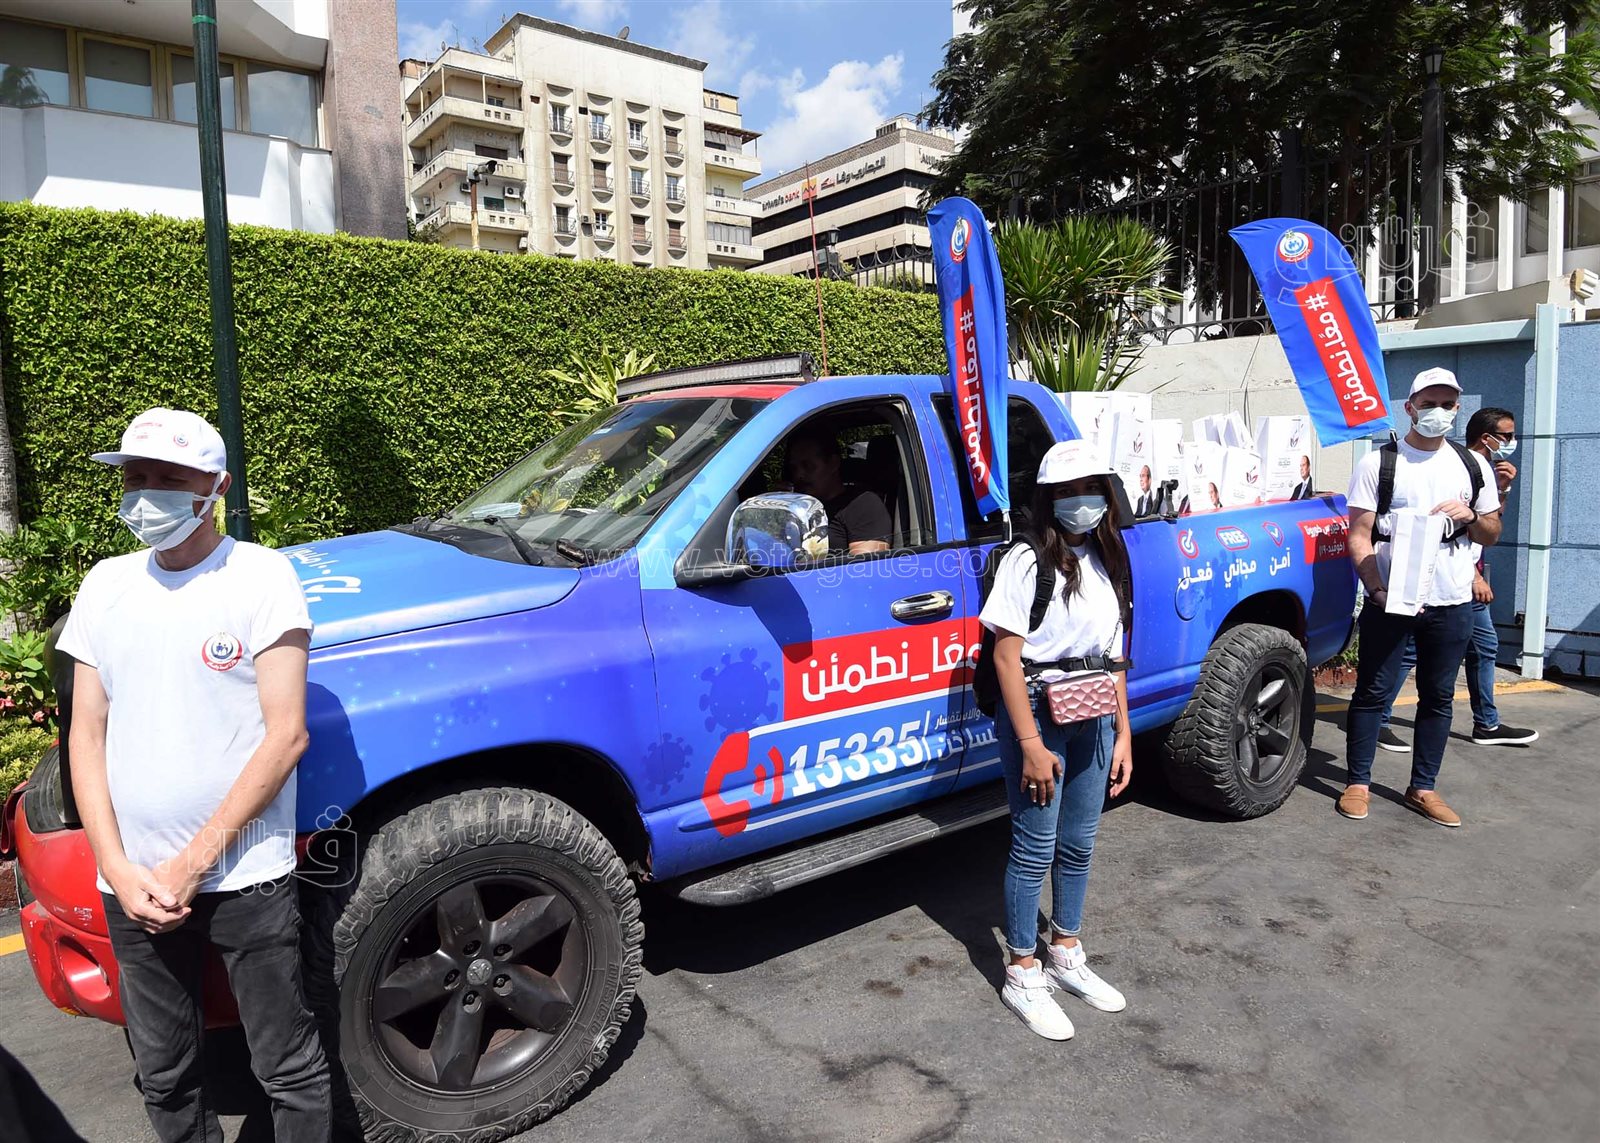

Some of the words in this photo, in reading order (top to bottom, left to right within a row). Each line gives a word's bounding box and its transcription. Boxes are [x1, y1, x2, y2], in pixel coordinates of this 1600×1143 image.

[1219, 530, 1248, 546] FREE
[1224, 558, 1257, 588] مجاني
[1269, 547, 1291, 576] آمن
[1178, 562, 1213, 590] فعال
